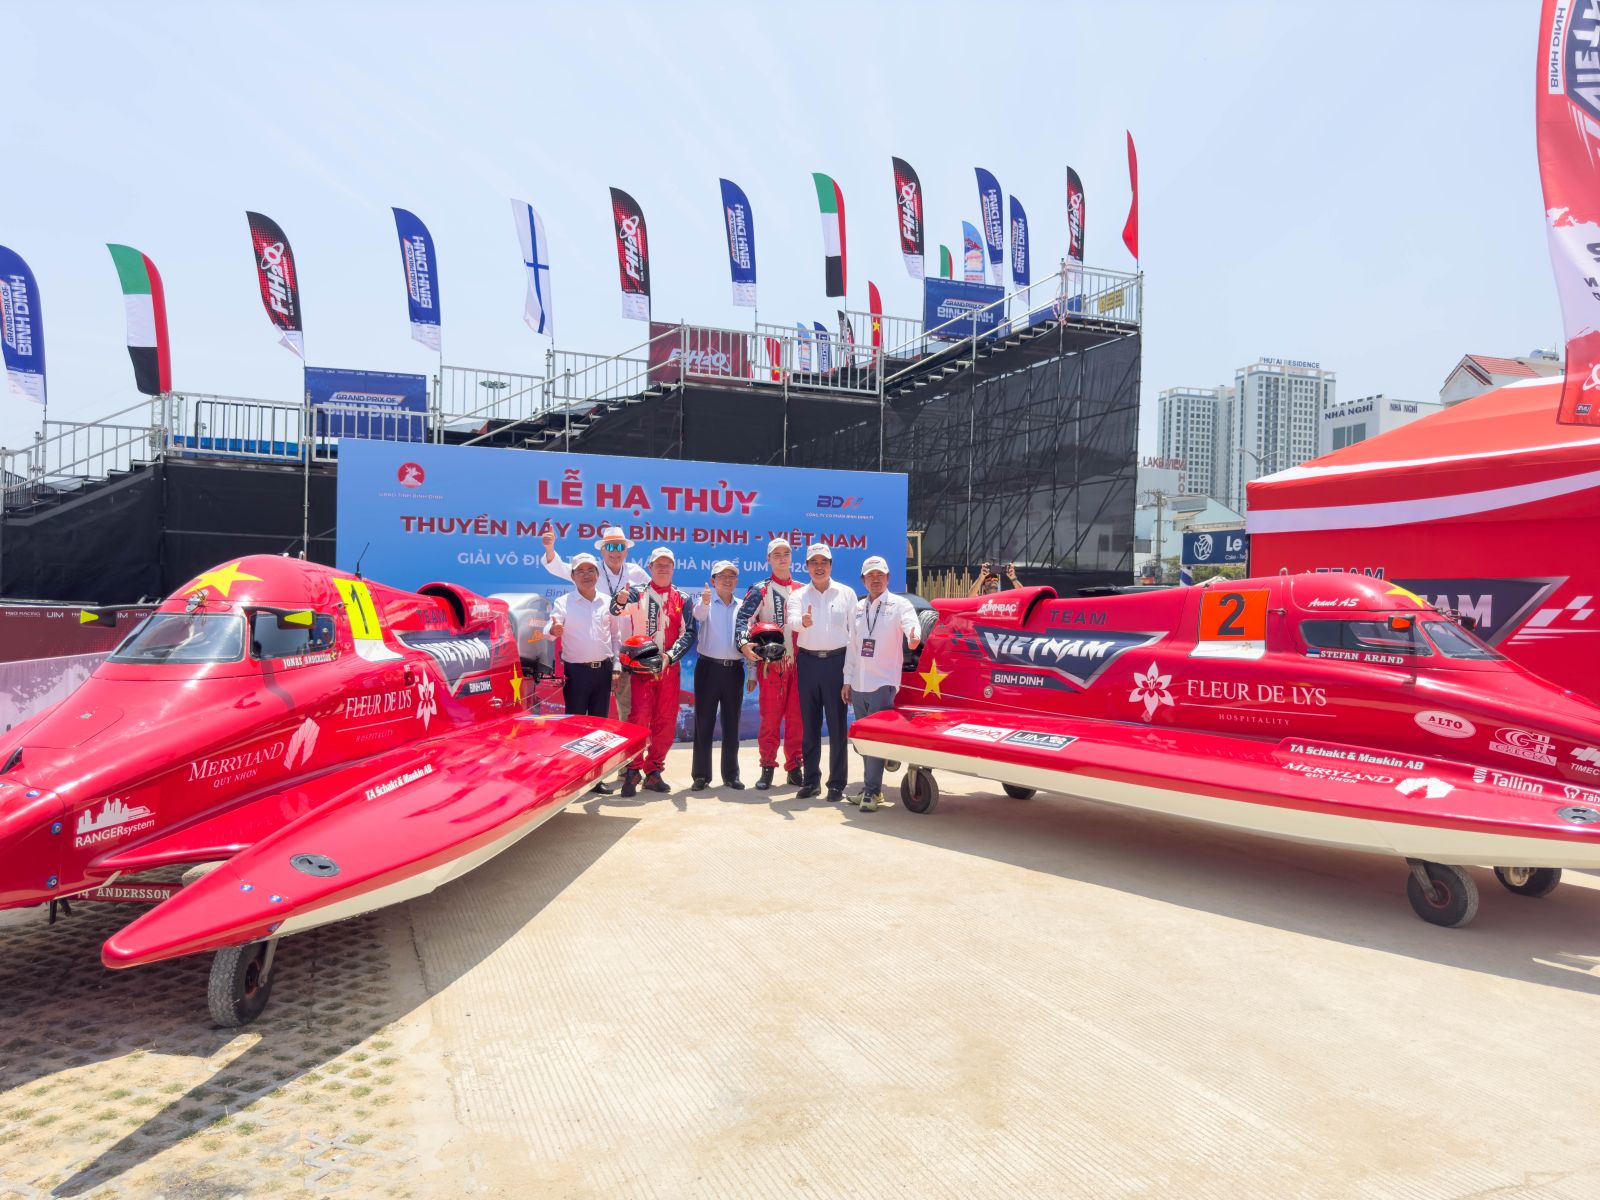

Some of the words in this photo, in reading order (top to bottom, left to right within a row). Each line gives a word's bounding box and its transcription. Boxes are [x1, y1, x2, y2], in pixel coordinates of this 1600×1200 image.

[412, 236, 428, 272] DINH
[10, 275, 30, 316] DINH
[417, 273, 432, 308] BINH
[16, 317, 33, 356] BINH
[538, 468, 583, 507] LỄ
[596, 483, 651, 517] HẠ
[660, 480, 758, 515] THỦY
[400, 513, 508, 536] THUYỀN
[516, 517, 571, 538] MÁY
[629, 522, 686, 542] BÌNH
[691, 528, 749, 548] ĐỊNH
[820, 533, 868, 549] NAM
[1226, 536, 1242, 551] Le
[457, 549, 490, 565] GIẢI
[495, 551, 518, 566] VÔ
[743, 560, 768, 572] UIM
[351, 584, 369, 634] 1
[416, 610, 448, 624] TEAM
[1050, 610, 1107, 625] TEAM
[1217, 594, 1245, 635] 2
[412, 637, 490, 668] VIETNAM
[984, 632, 1115, 663] VIETNAM
[1320, 650, 1359, 661] STEFAN
[1364, 654, 1404, 665] ARAND
[994, 673, 1017, 684] BINH
[1019, 675, 1044, 686] DINH
[1187, 679, 1251, 701] FLEUR
[1257, 684, 1285, 704] DE
[1292, 686, 1327, 707] LYS
[345, 694, 381, 719] FLEUR
[384, 691, 397, 713] DE
[398, 689, 412, 710] LYS
[1219, 713, 1290, 726] HOSPITALITY
[1429, 716, 1462, 729] ALTO
[187, 742, 285, 782] MERRYLAND
[1290, 743, 1304, 753] TA
[1306, 746, 1345, 759] Schakt
[1346, 751, 1356, 760] &
[1358, 753, 1403, 768] Maskin
[1404, 761, 1425, 770] AB
[1571, 763, 1600, 776] TIMEC
[1283, 763, 1395, 784] MERRYLAND
[1491, 772, 1543, 794] Tallinn
[365, 789, 376, 800] TA
[75, 819, 155, 848] RANGERsystem
[96, 887, 170, 899] ANDERSSON
